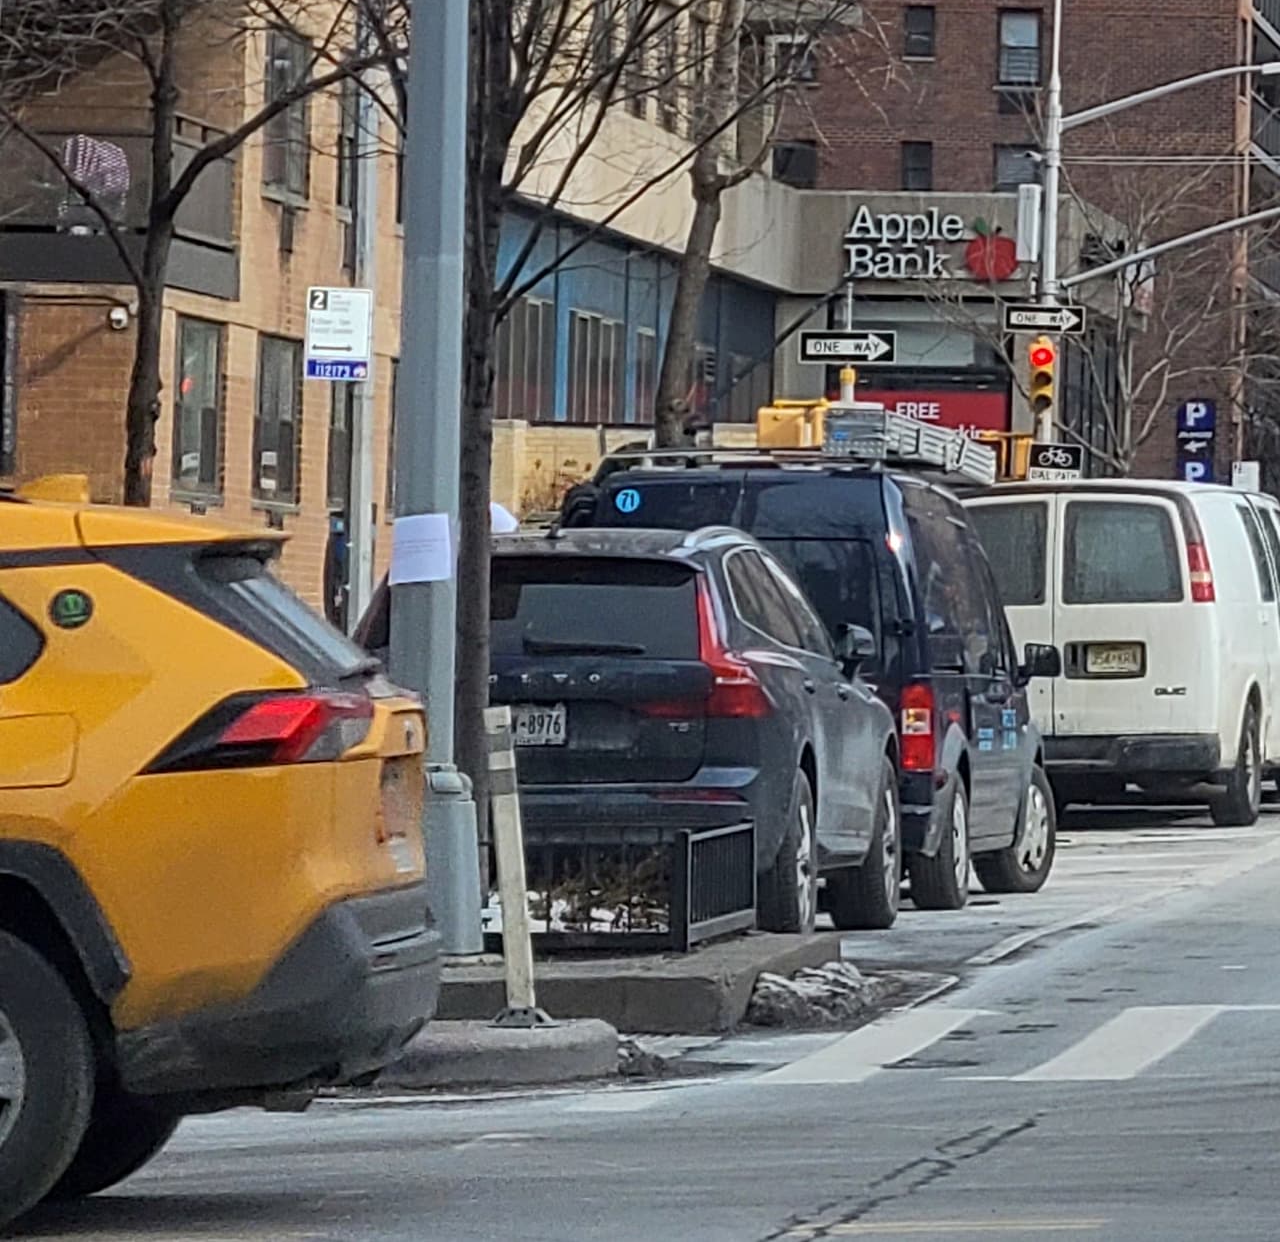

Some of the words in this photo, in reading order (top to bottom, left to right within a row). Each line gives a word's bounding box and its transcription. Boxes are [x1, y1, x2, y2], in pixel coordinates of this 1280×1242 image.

[843, 204, 965, 248] Apple
[843, 244, 951, 279] Bank
[312, 291, 325, 309] 2
[1016, 313, 1038, 323] ONE
[1050, 314, 1073, 325] WAY
[813, 341, 841, 353] ONE
[853, 341, 881, 353] WAY
[896, 402, 940, 420] FREE
[1186, 401, 1207, 427] P
[1185, 461, 1205, 482] P
